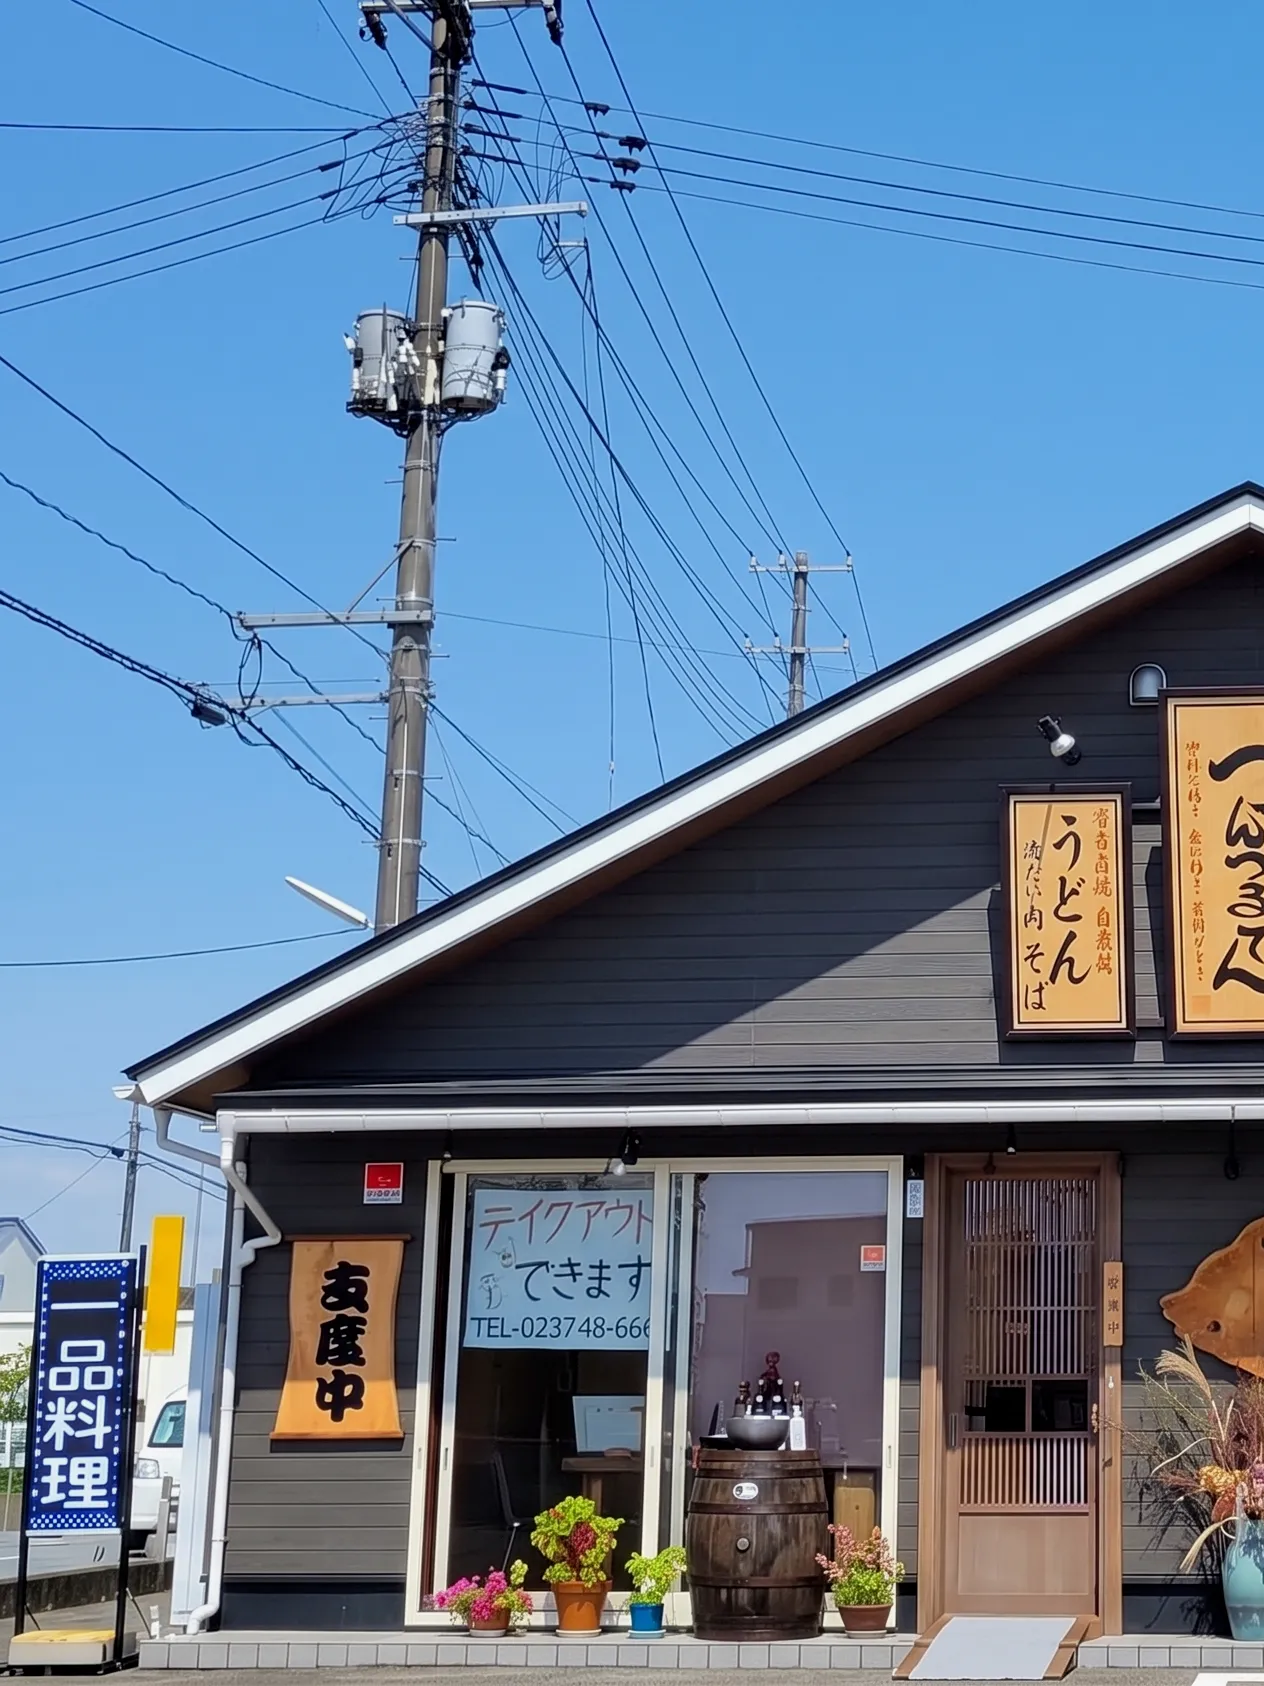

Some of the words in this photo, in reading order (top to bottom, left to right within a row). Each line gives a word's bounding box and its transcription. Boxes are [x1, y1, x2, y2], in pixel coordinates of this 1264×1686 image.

[1050, 814, 1092, 985] うどん
[479, 1198, 652, 1250] テイクアウト
[515, 1254, 652, 1303] できます
[40, 1301, 120, 1510] 一品料理
